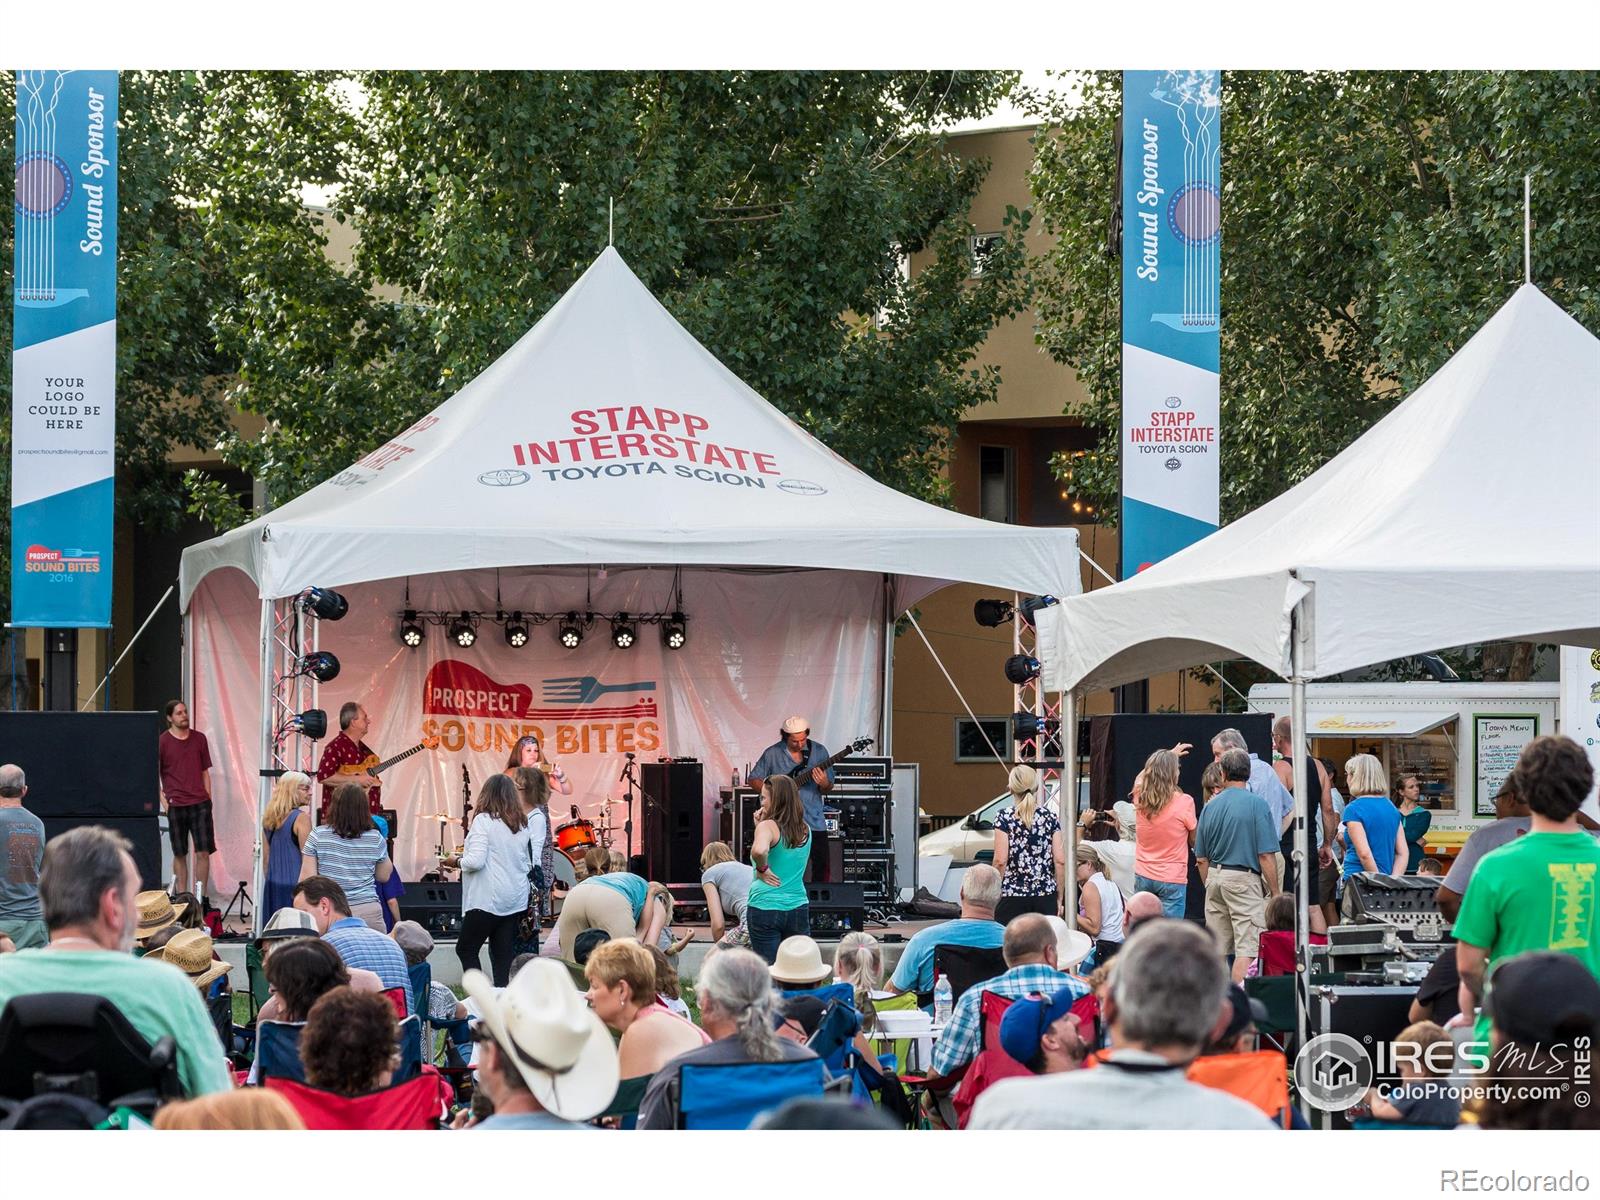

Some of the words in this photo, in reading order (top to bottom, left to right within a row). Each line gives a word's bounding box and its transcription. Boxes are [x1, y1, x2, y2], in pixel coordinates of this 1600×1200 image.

[80, 87, 110, 178] Sponsor
[1136, 118, 1165, 207] Sponsor
[80, 183, 103, 256] Sound
[1136, 212, 1159, 282] Sound
[45, 378, 85, 388] YOUR
[45, 391, 85, 402] LOGO
[28, 405, 79, 416] COULD
[84, 406, 101, 416] BE
[45, 420, 84, 430] HERE
[570, 405, 710, 439] STAPP
[1150, 411, 1195, 427] STAPP
[1130, 427, 1215, 443] INTERSTATE
[512, 433, 781, 476] INTERSTATE
[1138, 445, 1176, 454] TOYOTA
[1178, 445, 1208, 454] SCION
[542, 461, 664, 483] TOYOTA
[673, 463, 767, 489] SCION
[29, 551, 58, 561] PROSPECT
[25, 562, 65, 573] SOUND
[67, 562, 100, 573] BITES
[49, 573, 74, 583] 2016
[432, 687, 521, 712] PROSPECT
[421, 719, 546, 753] SOUND
[555, 721, 661, 755] BITES
